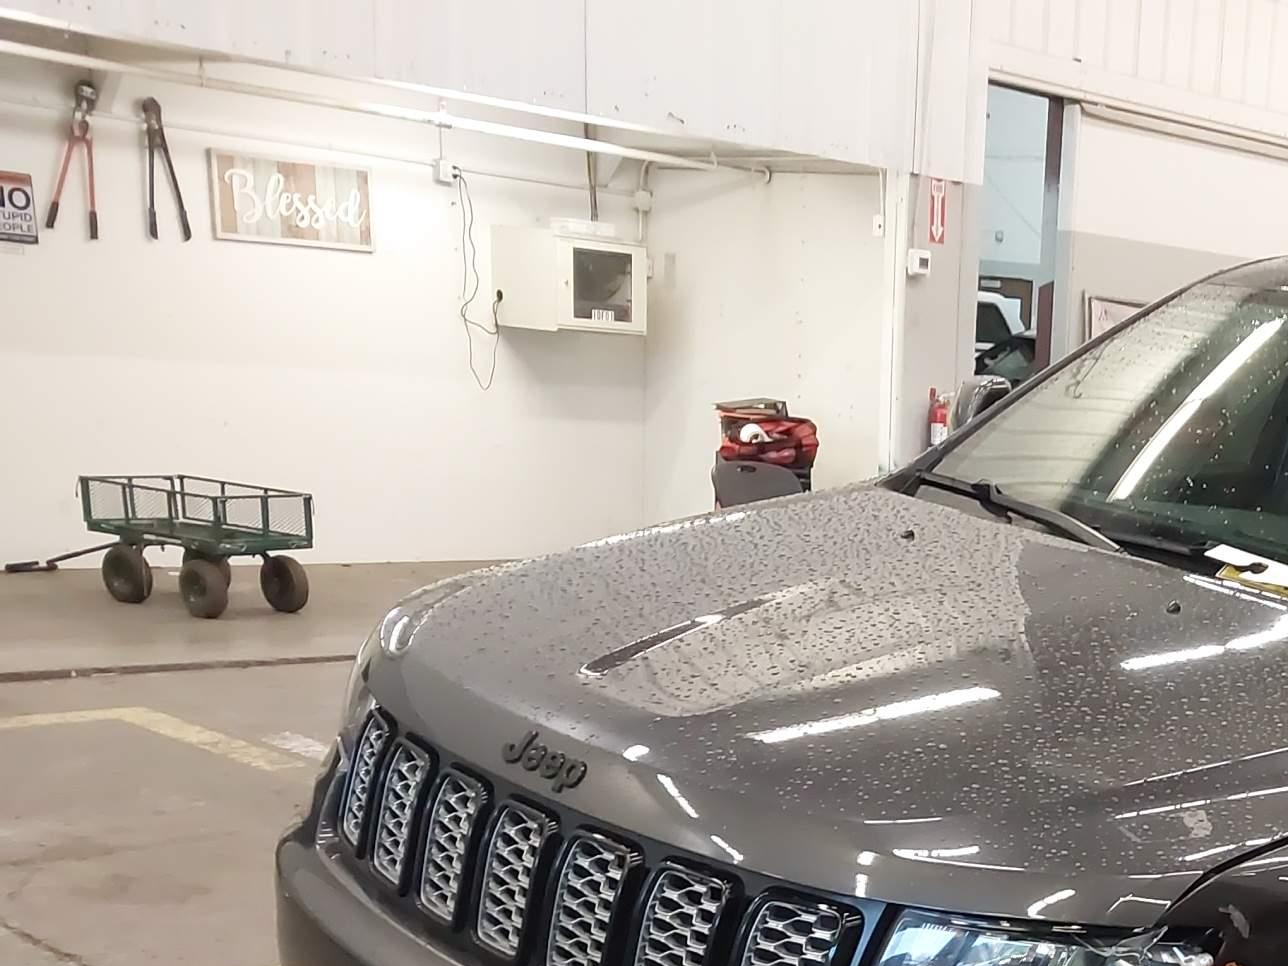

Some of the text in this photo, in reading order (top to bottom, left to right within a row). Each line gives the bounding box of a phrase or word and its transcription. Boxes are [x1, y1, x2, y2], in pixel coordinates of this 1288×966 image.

[0, 185, 31, 211] O
[0, 211, 33, 222] UPID
[224, 168, 367, 229] Blessed
[502, 730, 588, 794] Jeep
